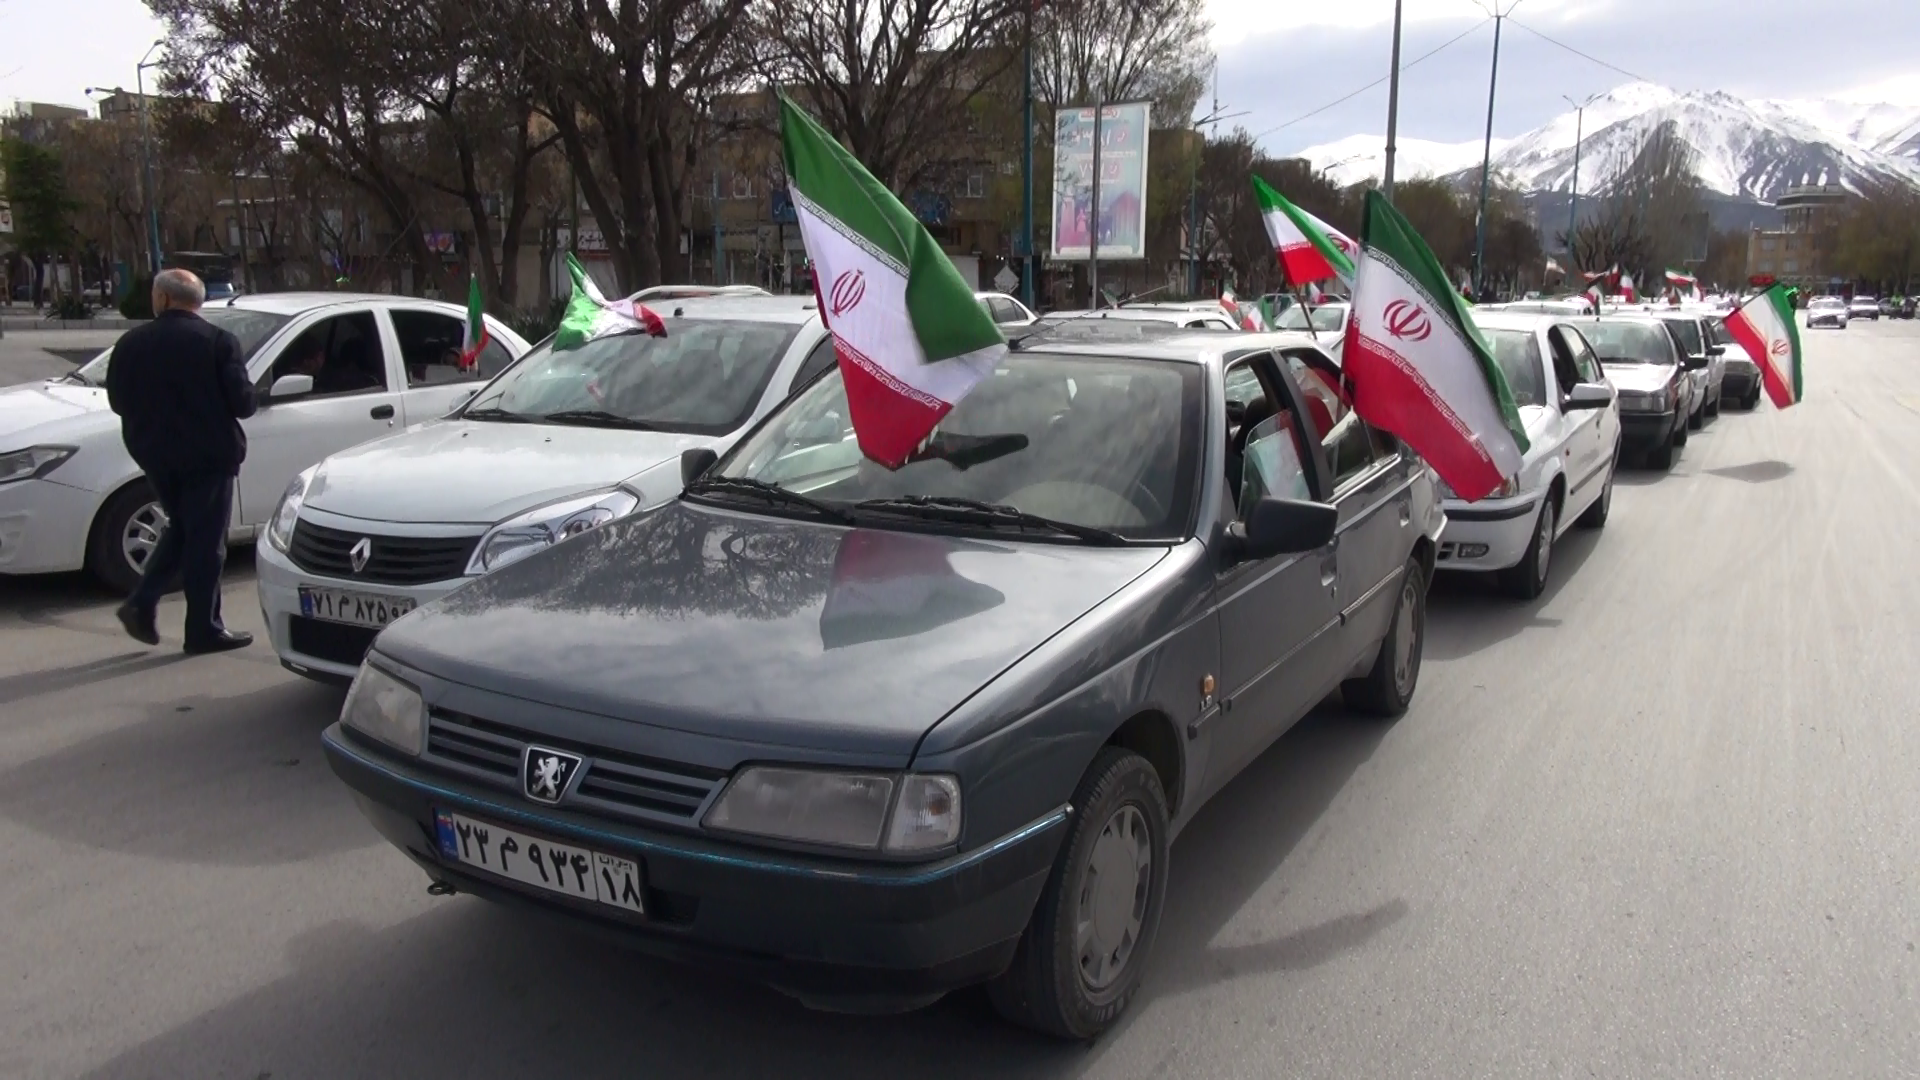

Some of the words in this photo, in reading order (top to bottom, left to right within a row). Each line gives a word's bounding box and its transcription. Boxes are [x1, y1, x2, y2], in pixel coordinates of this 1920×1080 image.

[313, 593, 333, 616] ۷۱
[456, 820, 489, 864] ۲۳
[500, 837, 519, 872] م
[528, 843, 589, 892] ۹۳۴
[602, 867, 641, 908] ۱۸
